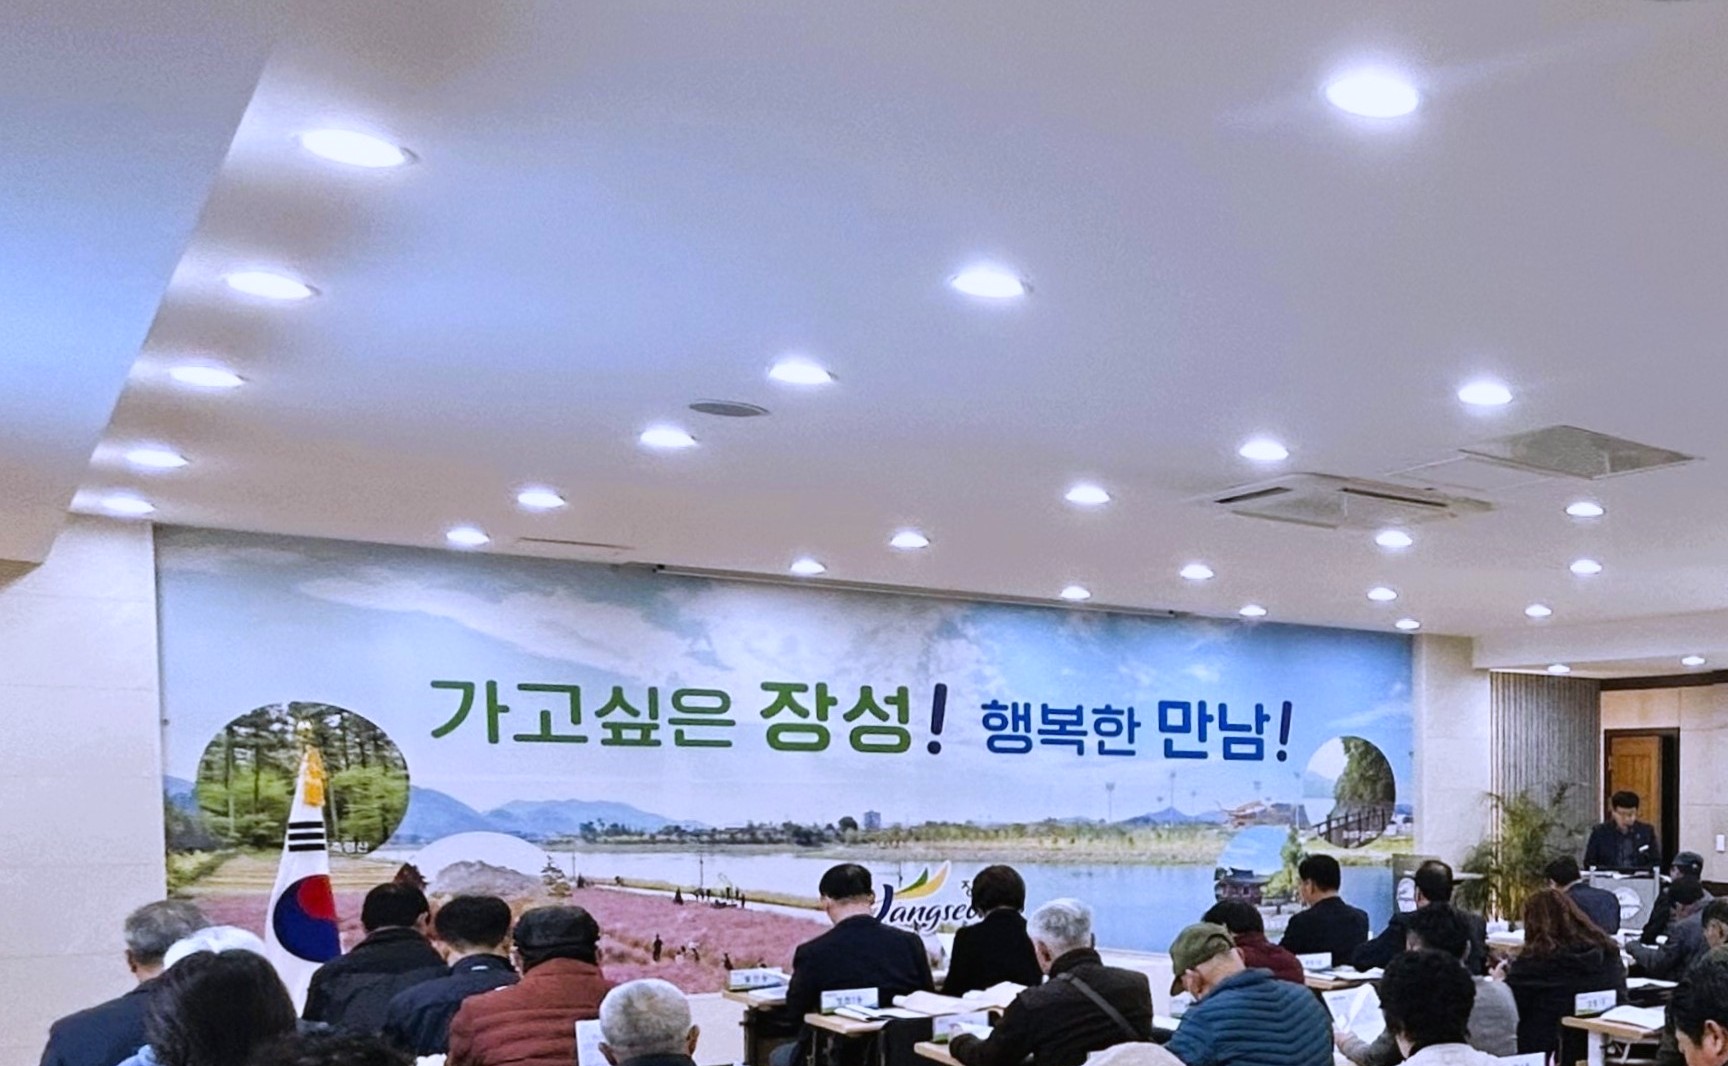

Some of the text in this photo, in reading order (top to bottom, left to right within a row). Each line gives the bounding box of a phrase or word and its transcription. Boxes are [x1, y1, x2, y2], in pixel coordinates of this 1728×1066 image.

[430, 679, 1293, 762] 가고싶은 장성! 행복한 만남!
